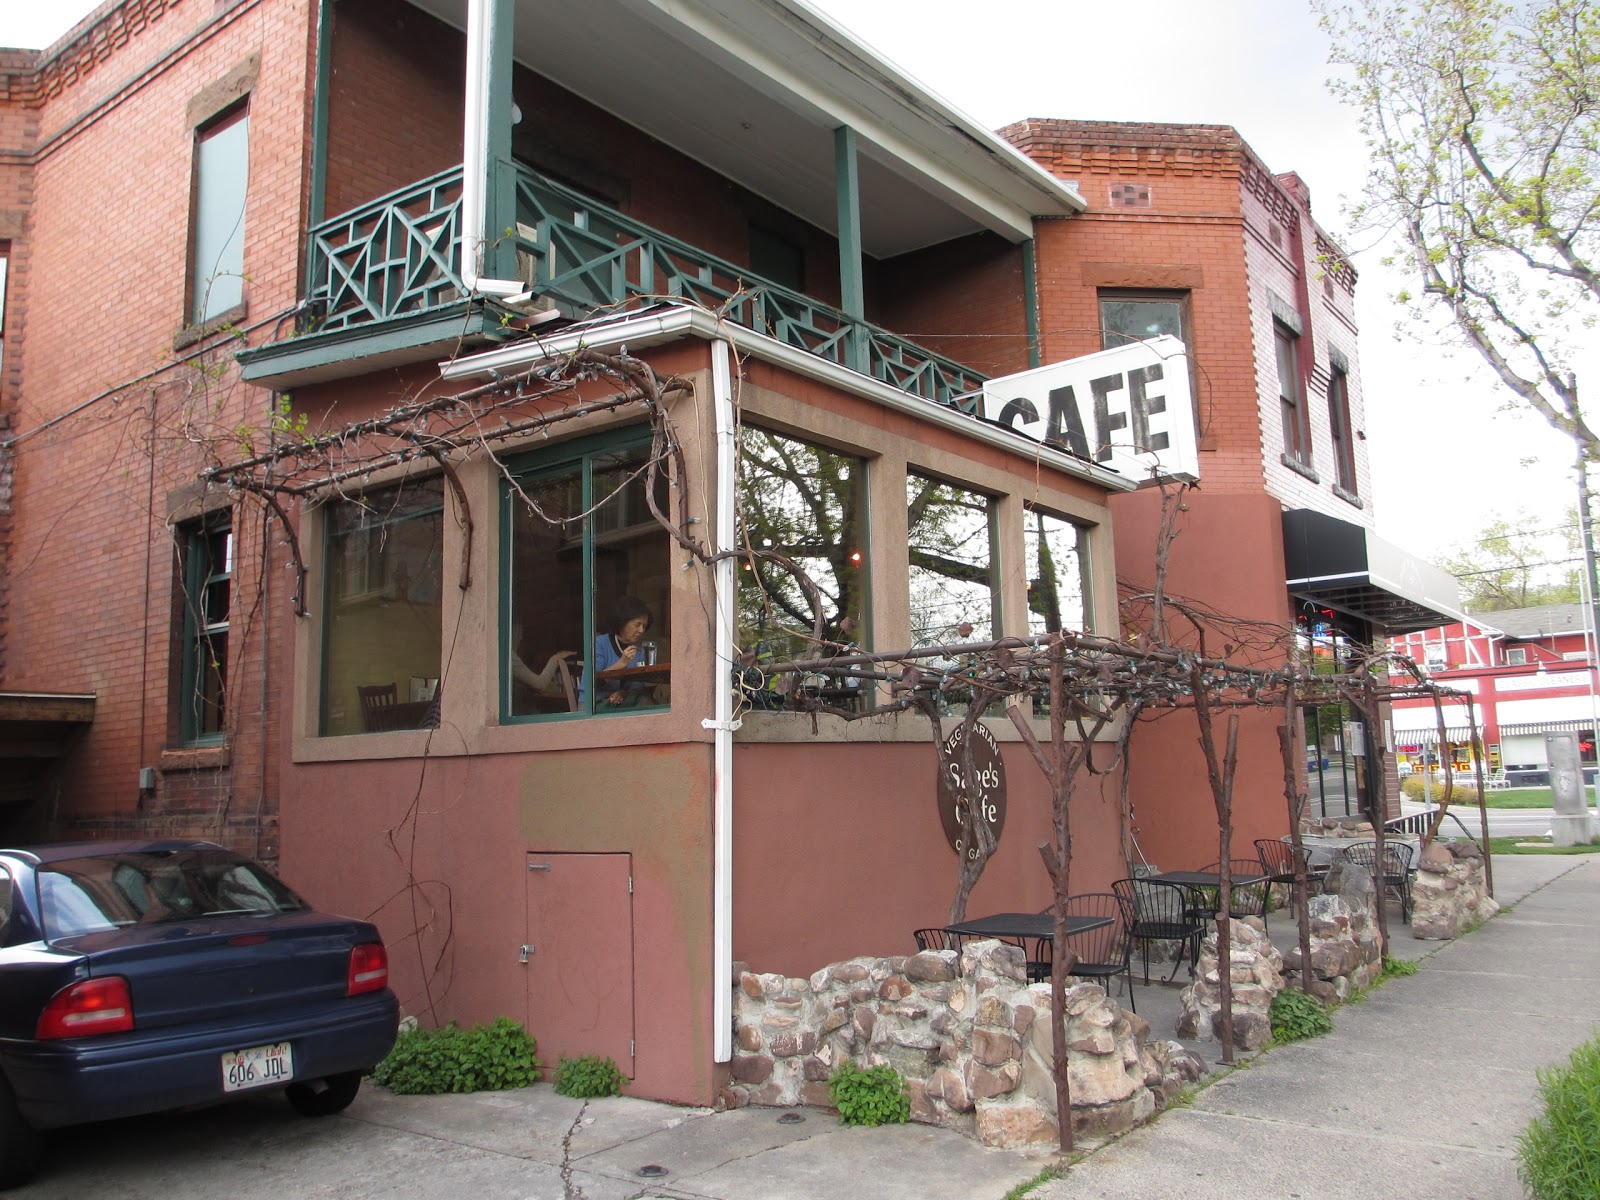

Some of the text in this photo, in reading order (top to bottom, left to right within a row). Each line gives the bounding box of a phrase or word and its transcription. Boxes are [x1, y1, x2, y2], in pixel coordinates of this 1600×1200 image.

[945, 723, 999, 756] VEGARIAN
[949, 762, 999, 797] Se's
[955, 795, 996, 825] fe
[229, 1062, 254, 1083] 606
[263, 1057, 288, 1078] JDL
